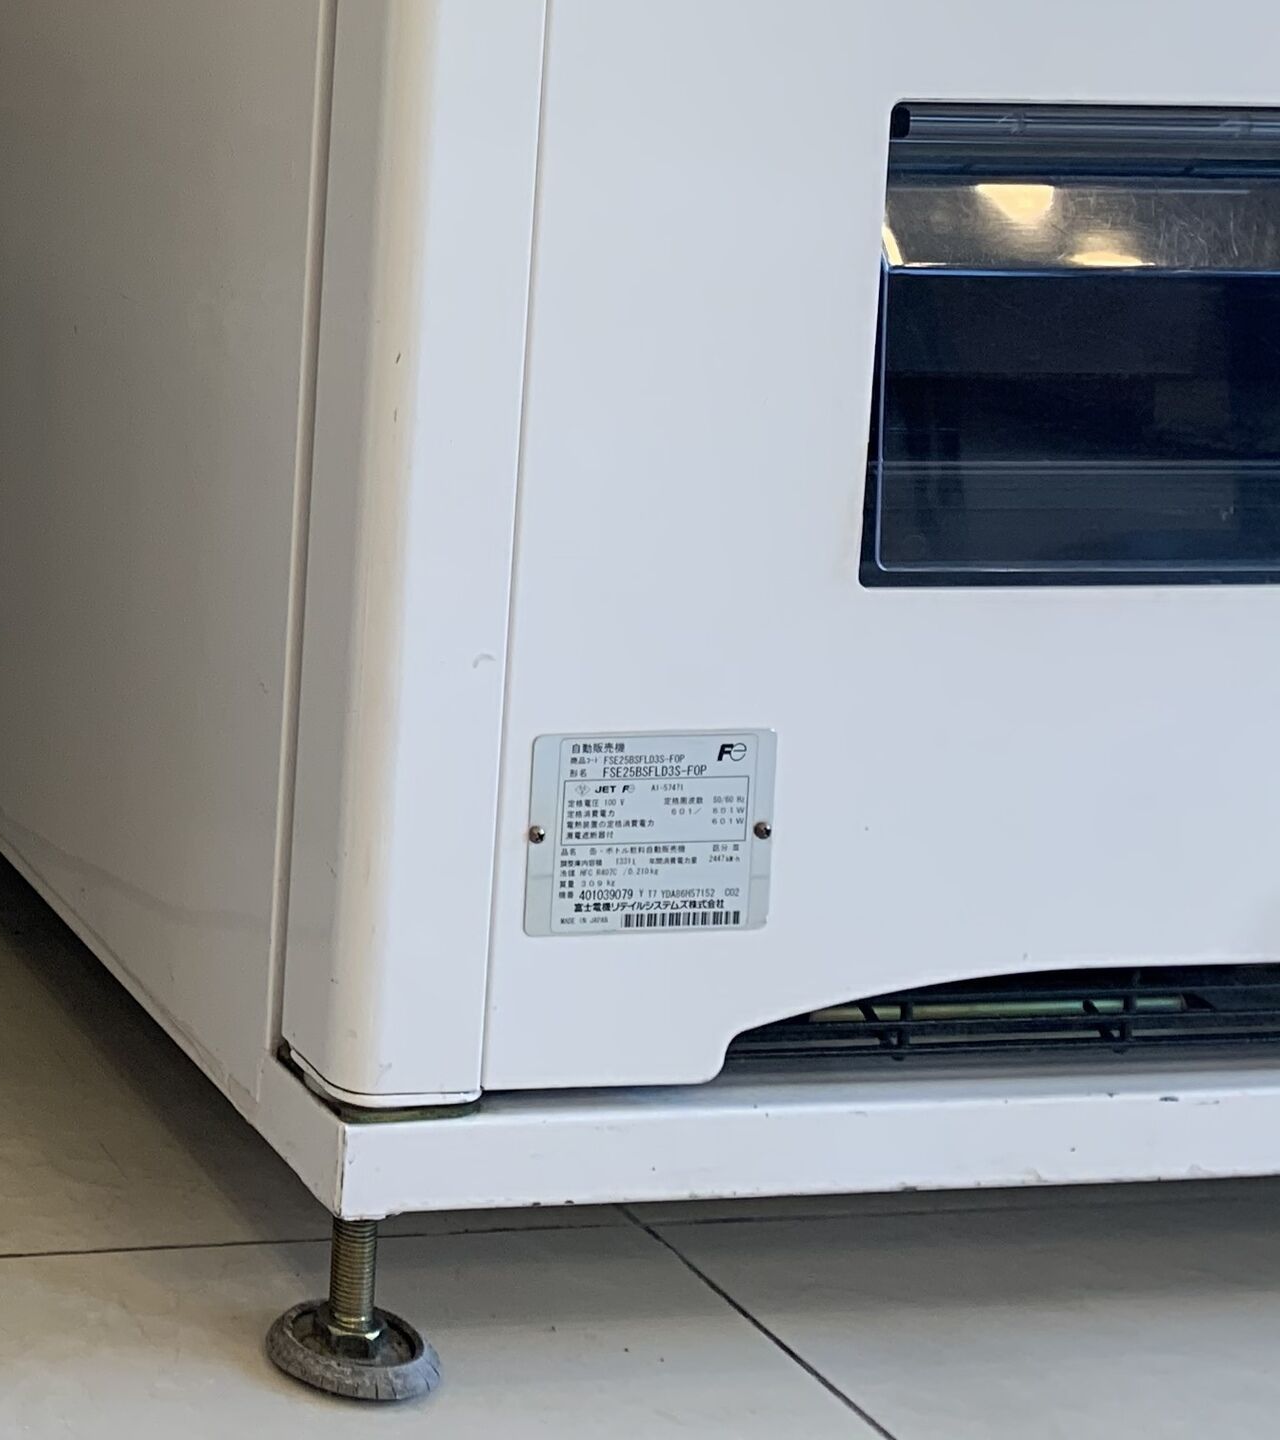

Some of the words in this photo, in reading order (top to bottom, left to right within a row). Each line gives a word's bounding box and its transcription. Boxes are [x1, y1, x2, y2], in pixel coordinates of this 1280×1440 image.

[572, 742, 625, 754] 自動販売機
[594, 784, 616, 794] JET
[578, 888, 634, 901] 401039079
[573, 899, 725, 913] 富士電機リテイルシステムズ株式会社
